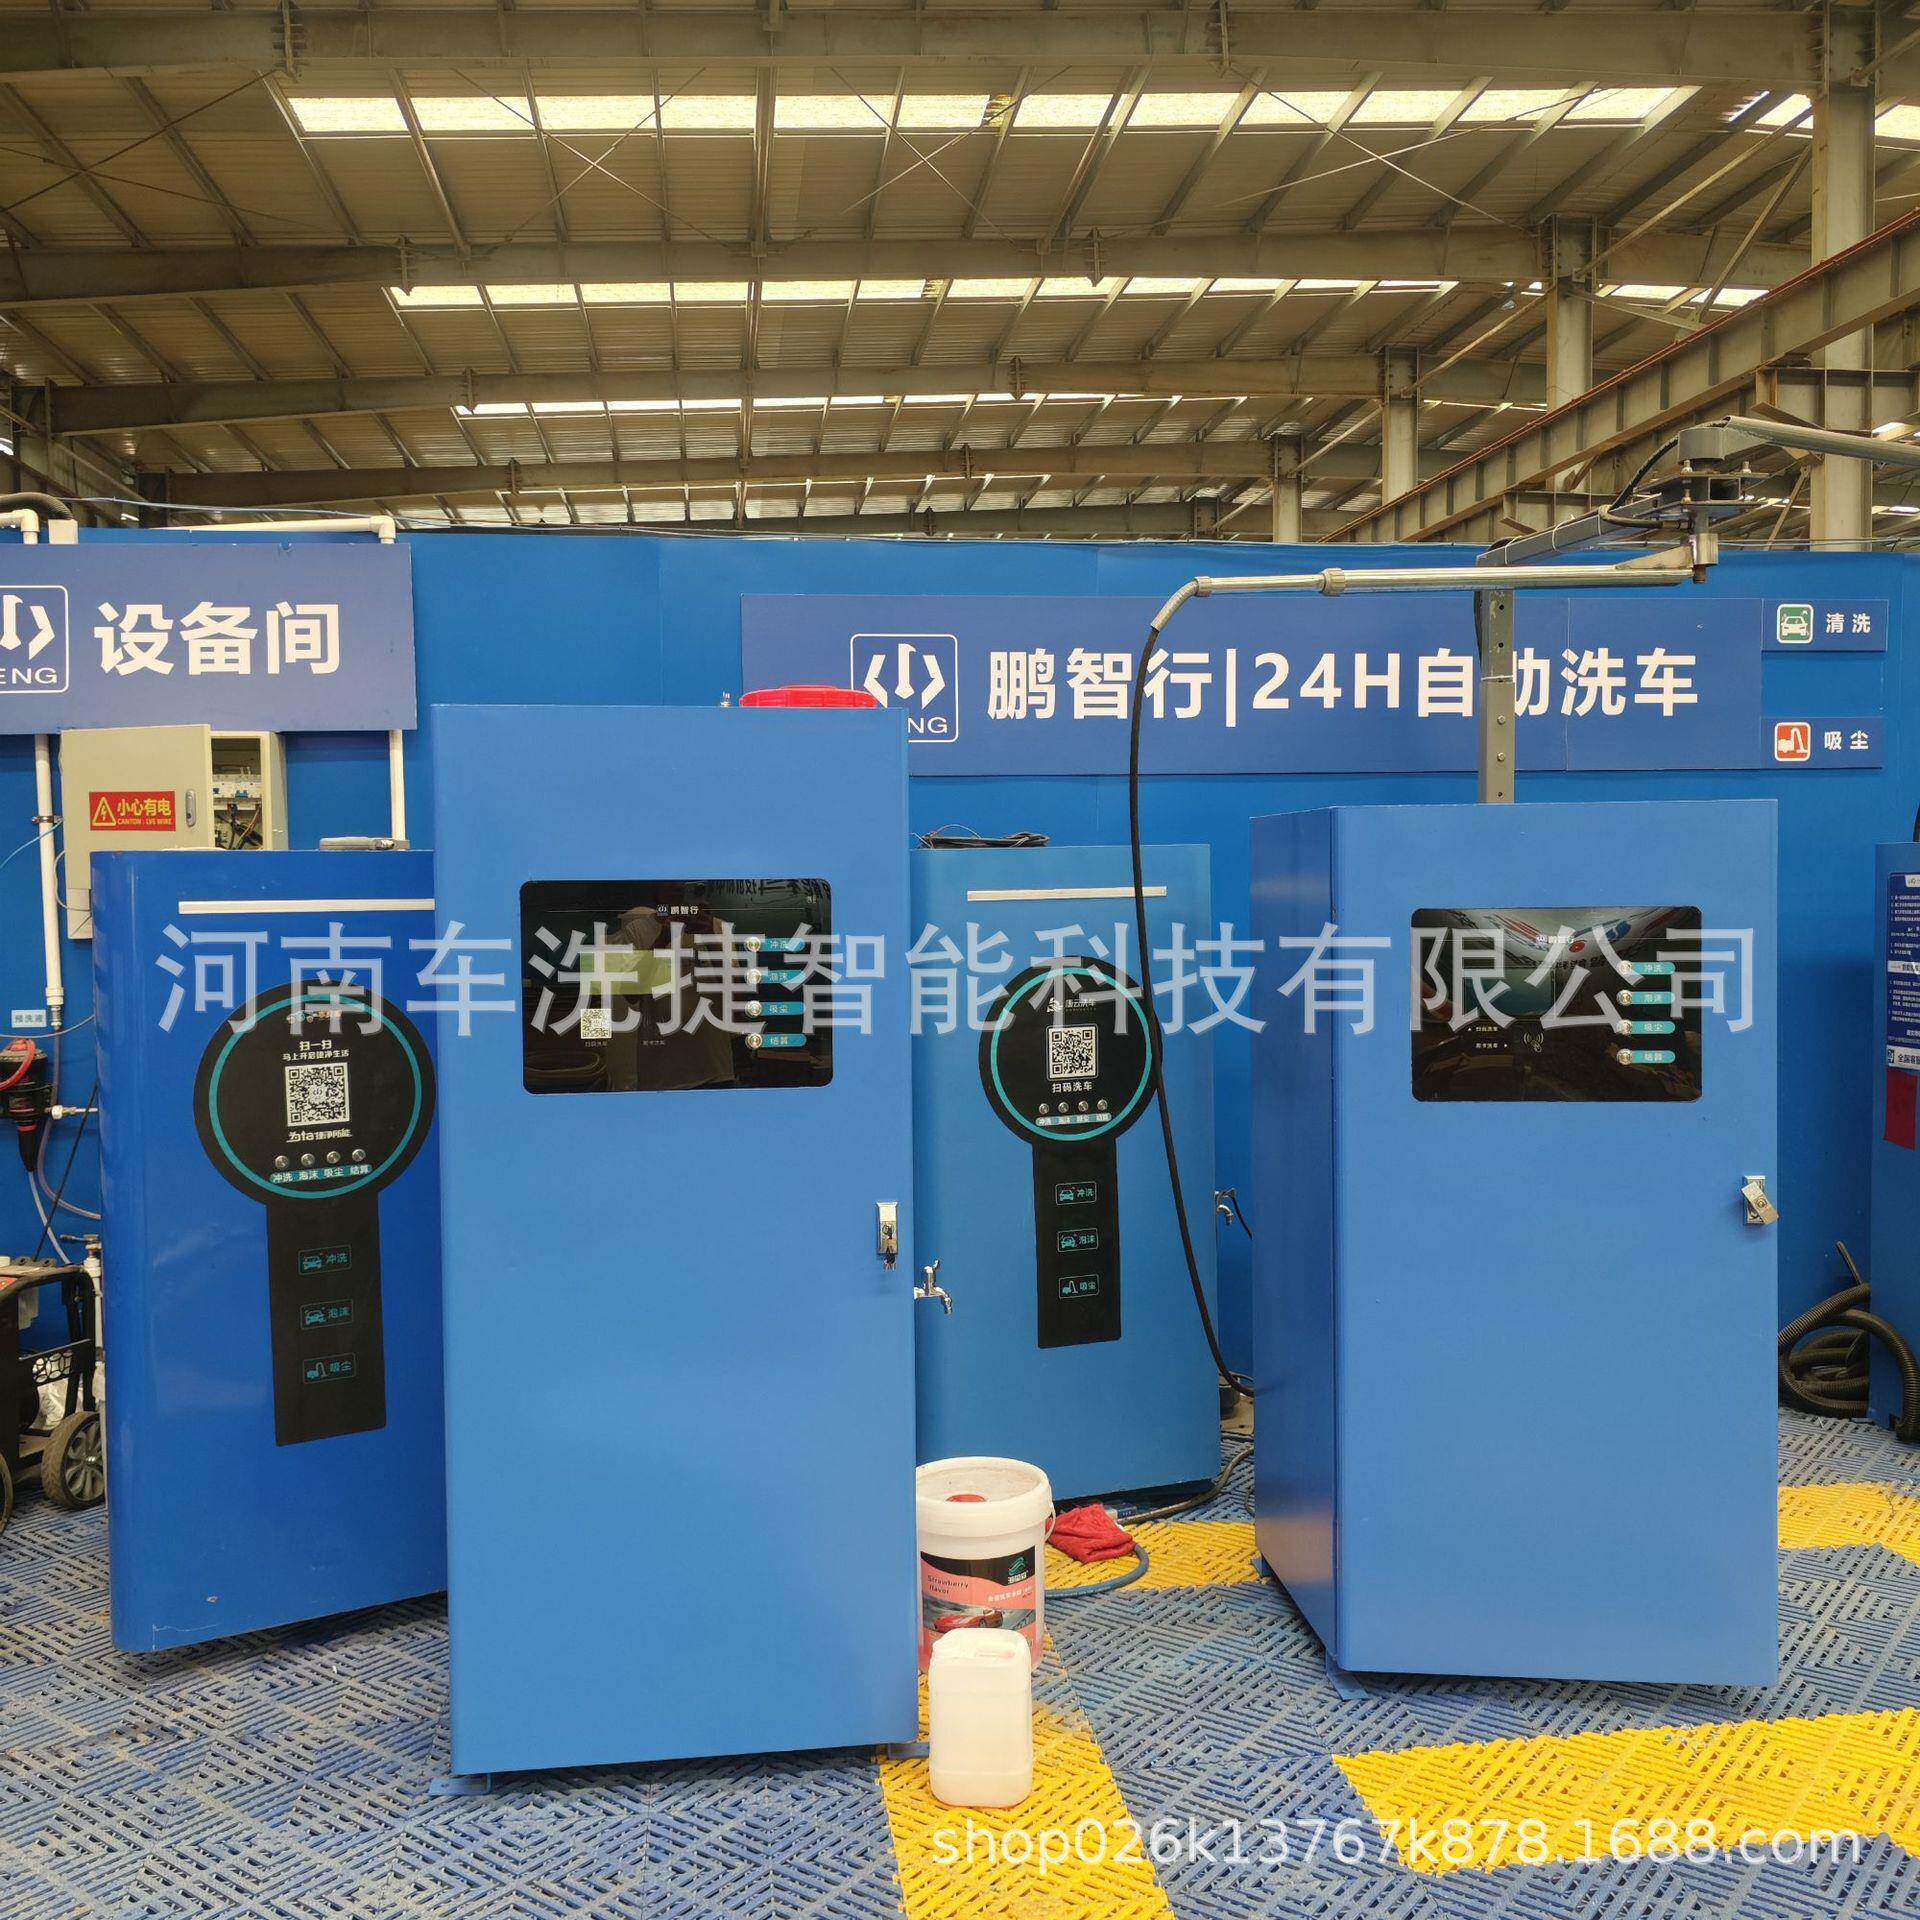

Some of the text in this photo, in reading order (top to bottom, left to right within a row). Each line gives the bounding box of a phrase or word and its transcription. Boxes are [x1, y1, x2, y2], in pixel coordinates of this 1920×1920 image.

[1825, 612, 1871, 635] 清洗
[94, 601, 341, 677] 设备间
[1823, 730, 1869, 752] 吸尘
[117, 798, 172, 817] 小心有电
[299, 1039, 332, 1052] 扫一扫
[1051, 1081, 1093, 1094] 扫码洗车
